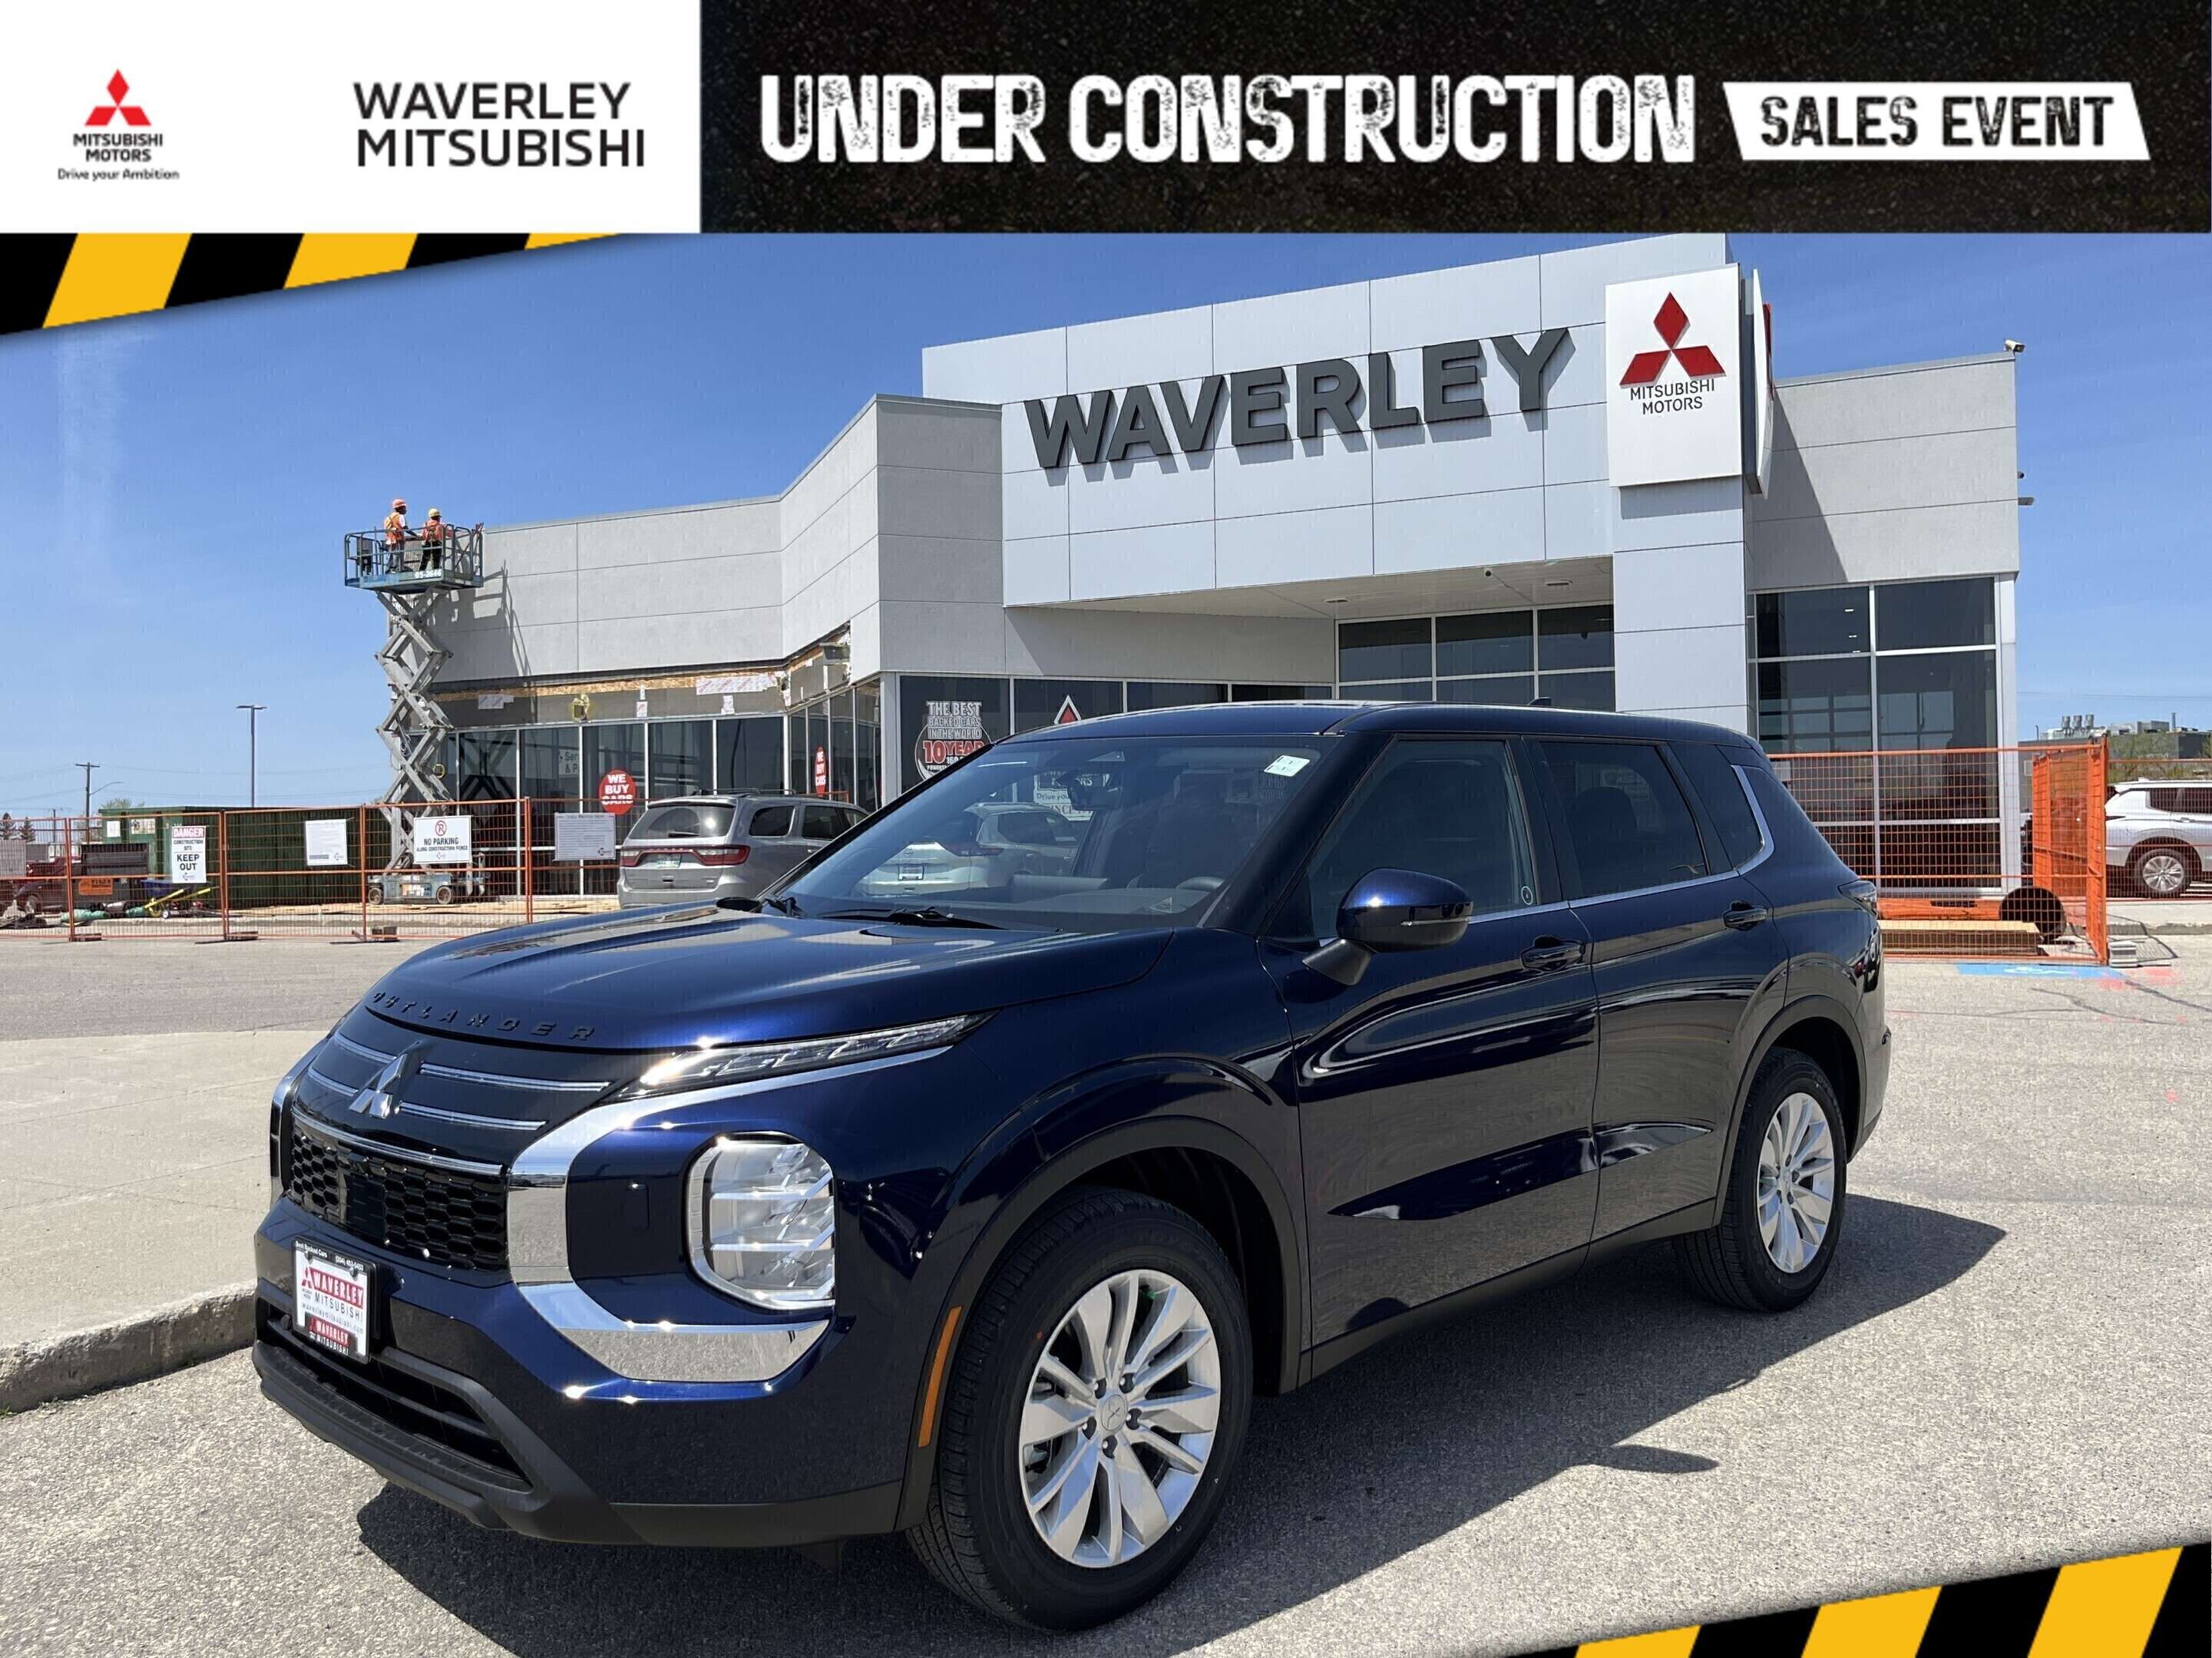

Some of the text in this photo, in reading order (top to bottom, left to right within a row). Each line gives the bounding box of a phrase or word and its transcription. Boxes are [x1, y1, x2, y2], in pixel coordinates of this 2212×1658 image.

[1024, 328, 1569, 468] WAVERLEY
[1630, 378, 1715, 401] MITSUBISHI
[1642, 396, 1703, 415] MOTORS
[927, 701, 982, 716] THE BEST
[928, 716, 981, 728] BACKED CARS
[928, 728, 982, 738] IN THE WORLD
[923, 740, 946, 764] 10
[603, 784, 629, 794] BUY
[607, 774, 627, 783] WE
[174, 828, 203, 837] DANGER
[373, 992, 595, 1042] OUTLANDER
[313, 1271, 363, 1305] WAVERLEY
[315, 1292, 363, 1322] MITSUBISHI
[316, 1320, 349, 1345] WAVERLEY
[317, 1335, 349, 1356] MITSUBISHI
